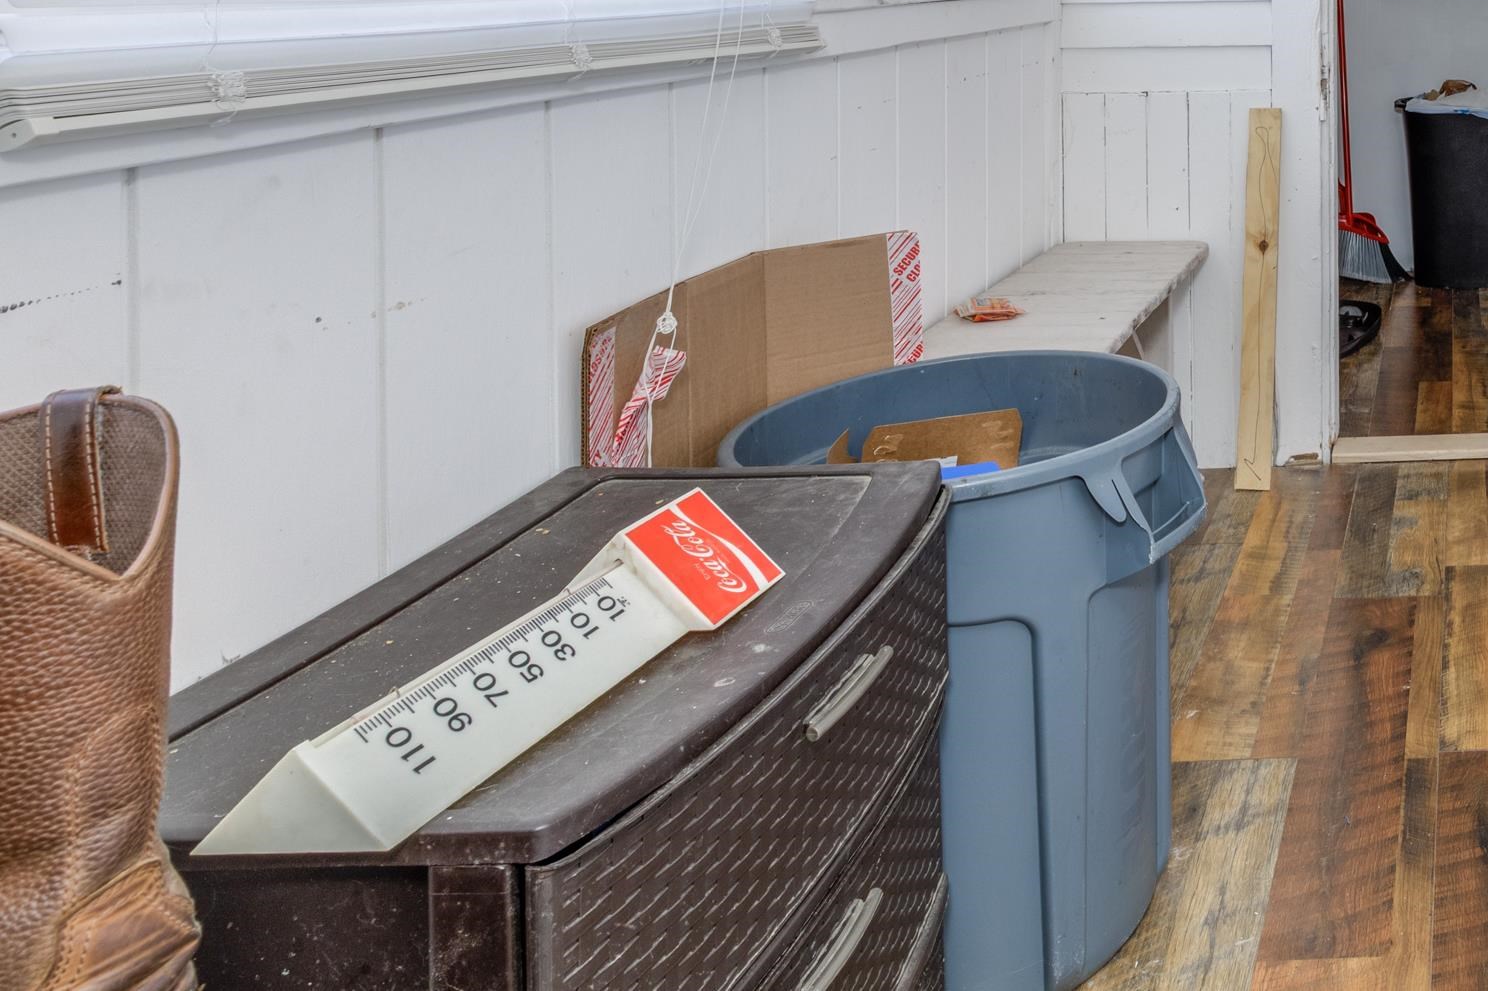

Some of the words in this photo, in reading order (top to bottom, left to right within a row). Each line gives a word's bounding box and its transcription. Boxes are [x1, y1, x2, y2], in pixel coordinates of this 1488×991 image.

[660, 519, 748, 593] Coca-Cola
[570, 611, 601, 641] 10
[597, 594, 626, 623] 10
[540, 629, 577, 662] 30
[507, 649, 545, 683] 50
[473, 672, 511, 708] 70
[432, 696, 473, 733] 90
[385, 725, 437, 775] 110
